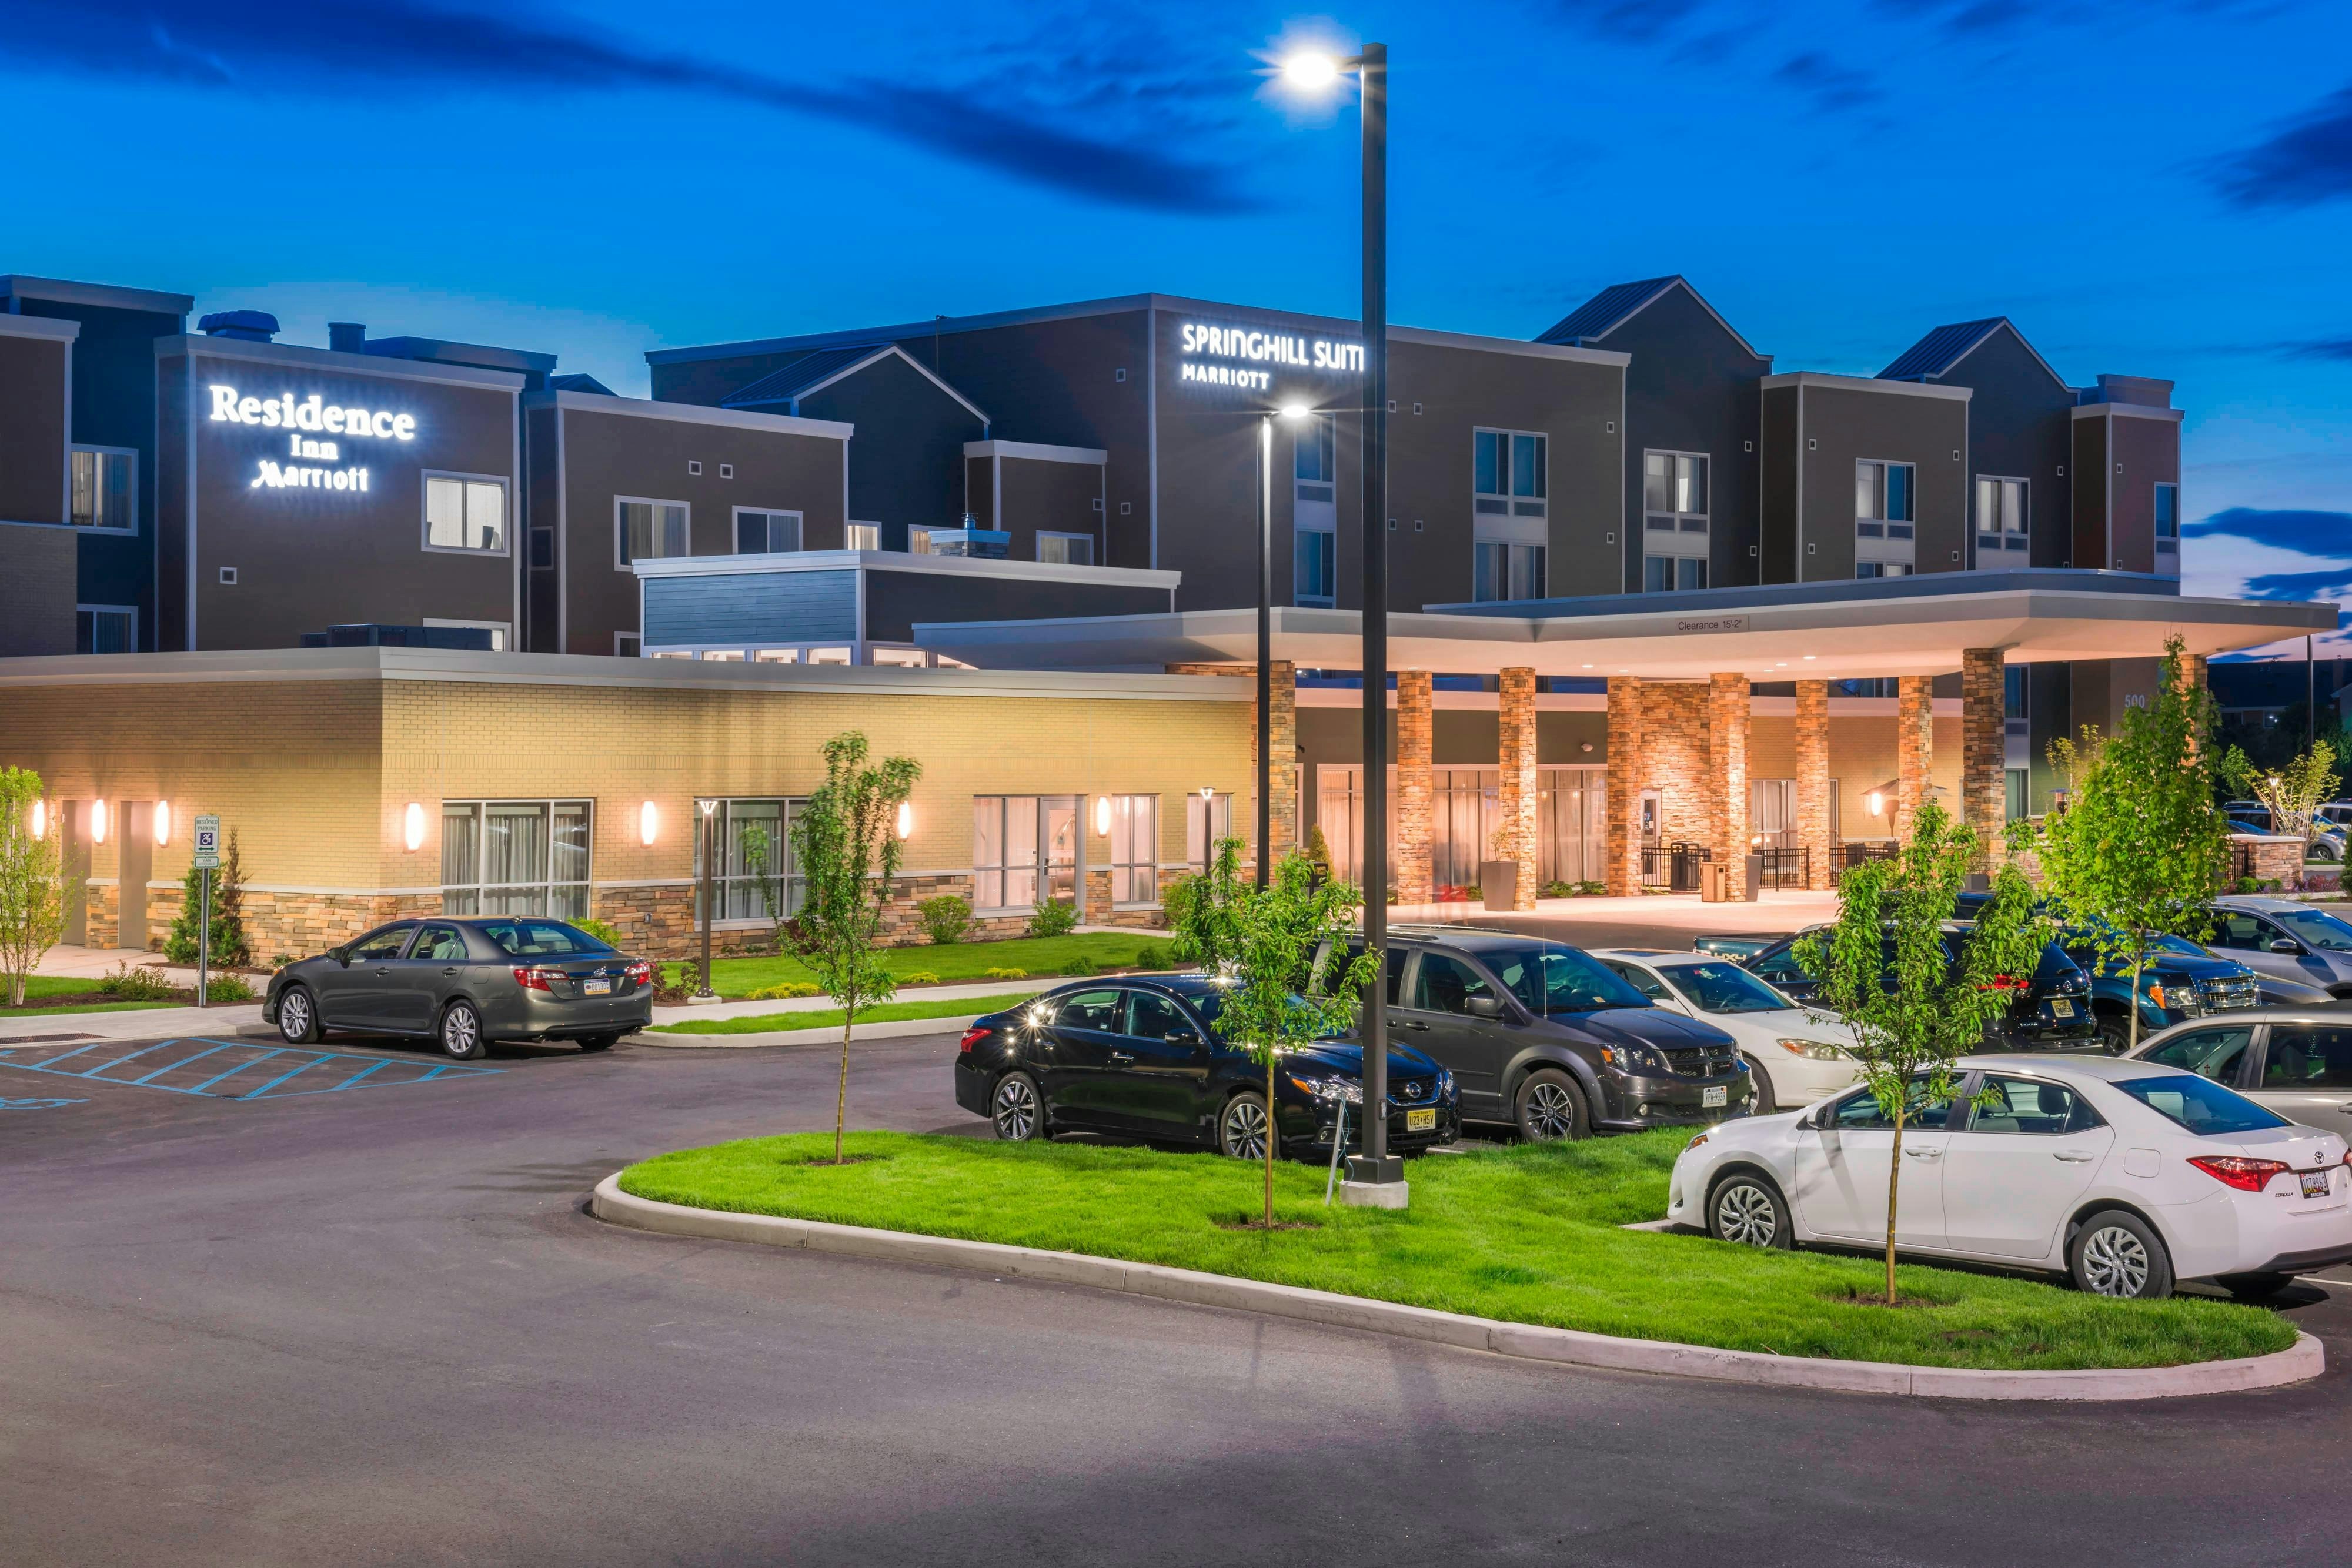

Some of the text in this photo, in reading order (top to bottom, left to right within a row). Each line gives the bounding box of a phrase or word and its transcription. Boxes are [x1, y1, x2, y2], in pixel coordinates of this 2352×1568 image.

[1182, 323, 1309, 366] SPRINGHILL
[1182, 363, 1270, 389] MARRIOTT
[209, 385, 415, 440] Residence
[290, 434, 339, 460] Inn
[251, 460, 369, 492] Marriott
[1678, 621, 1718, 630] Clearance
[2124, 694, 2145, 708] 500
